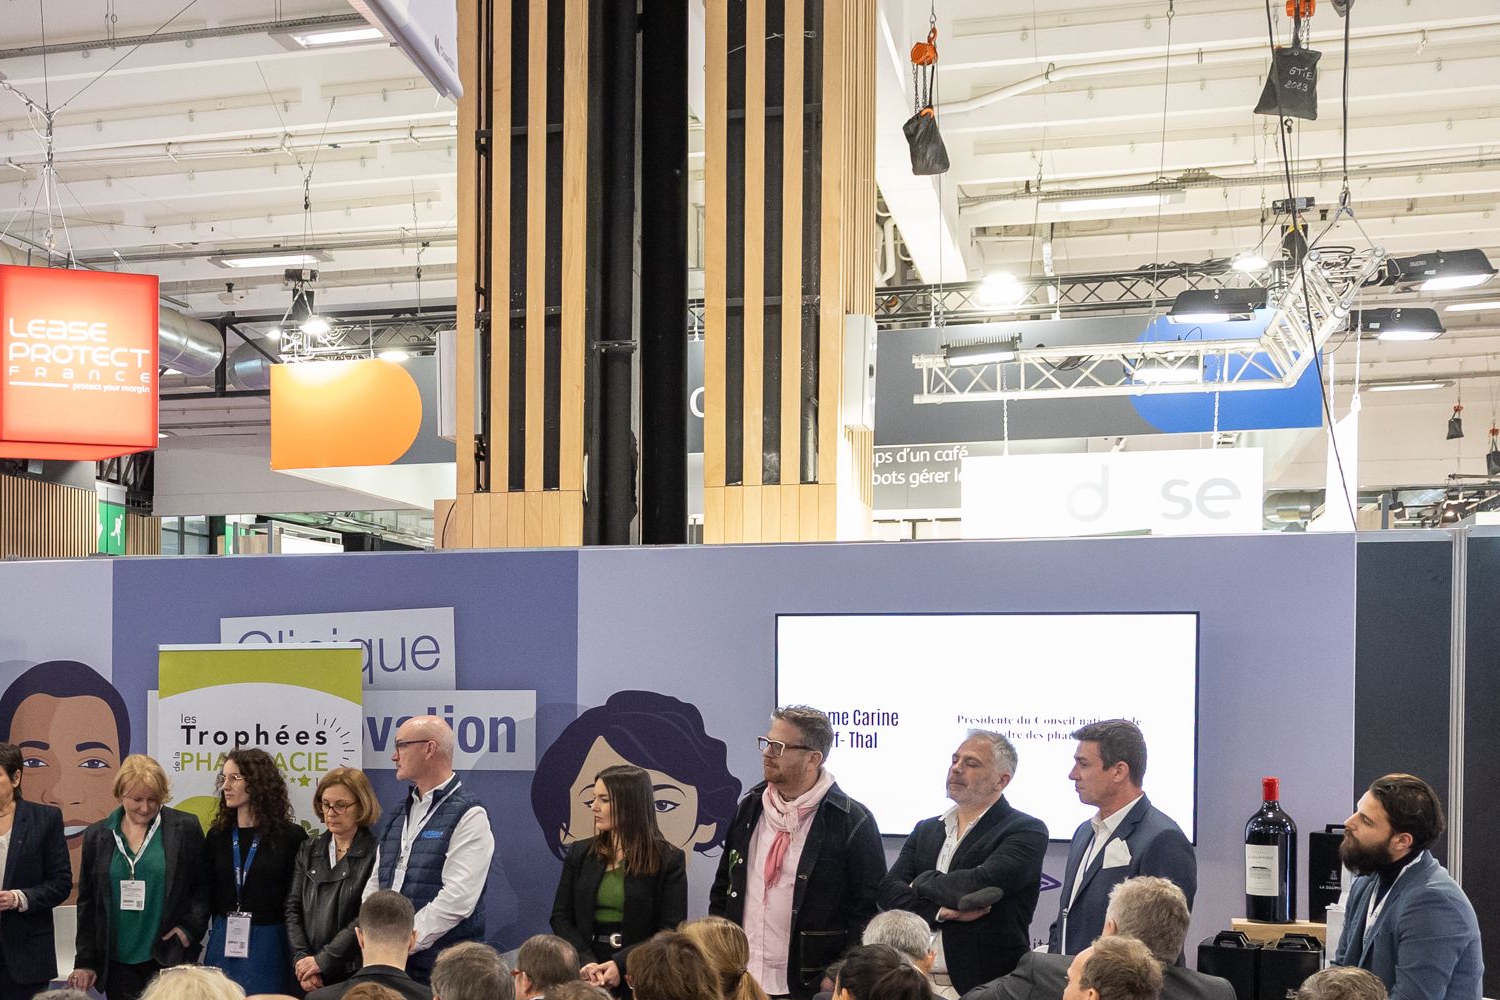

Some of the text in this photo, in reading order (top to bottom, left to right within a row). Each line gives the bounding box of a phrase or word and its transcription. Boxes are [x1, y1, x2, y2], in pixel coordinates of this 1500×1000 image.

[102, 384, 120, 392] your
[121, 385, 150, 394] margin
[934, 445, 969, 461] café
[909, 468, 950, 488] gérer
[180, 713, 197, 724] les
[853, 708, 899, 726] Carine
[1016, 715, 1031, 725] du
[1034, 715, 1076, 726] Conseil
[180, 723, 328, 751] Trophées
[848, 731, 878, 748] Thal
[1025, 731, 1044, 739] des
[180, 751, 329, 772] PHAACIE
